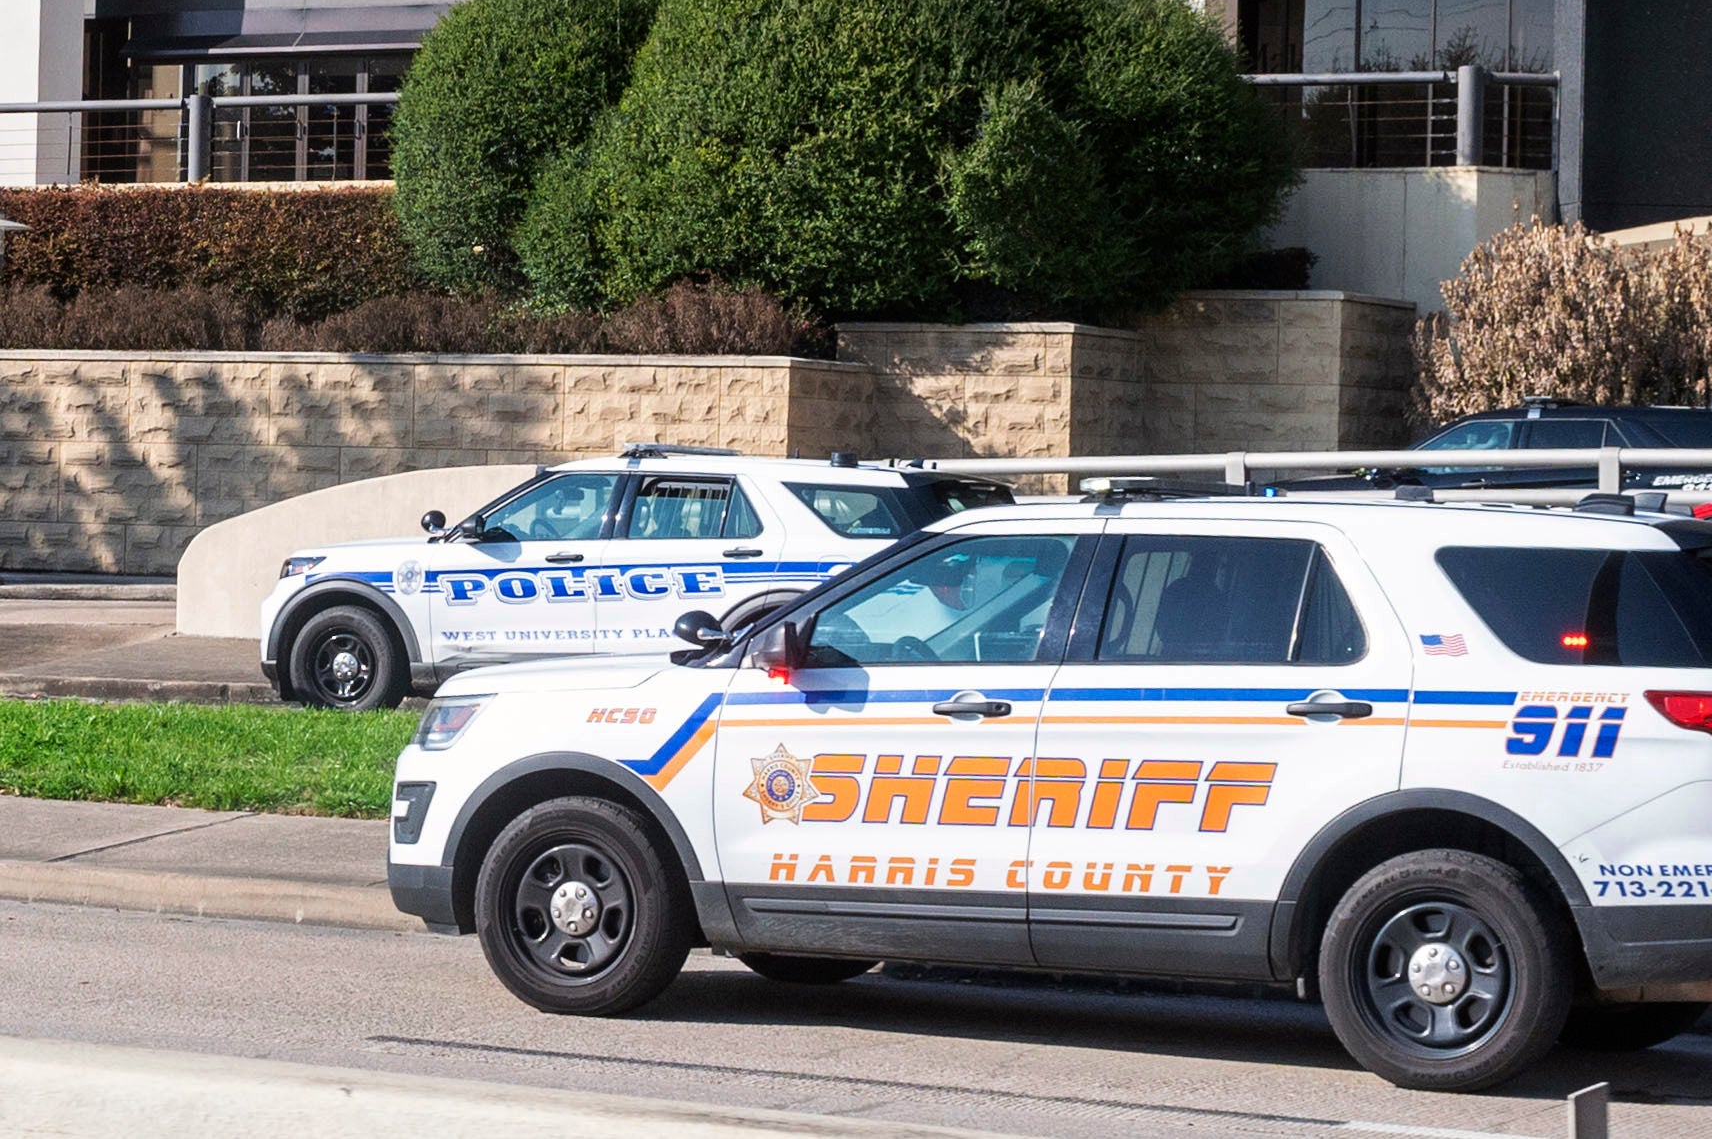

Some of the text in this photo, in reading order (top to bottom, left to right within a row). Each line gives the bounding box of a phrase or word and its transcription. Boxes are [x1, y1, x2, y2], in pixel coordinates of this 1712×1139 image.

[445, 566, 722, 605] POLICE
[442, 628, 675, 642] WEST UNIVERSITY PLA
[1519, 690, 1631, 704] EMERGENCY
[585, 707, 657, 724] HCSO
[1504, 704, 1629, 759] 911
[1502, 760, 1604, 773] Established 1837
[804, 753, 1279, 833] SHERIFF
[769, 851, 1235, 896] HARRIS COUNTY
[1600, 864, 1653, 878] NON
